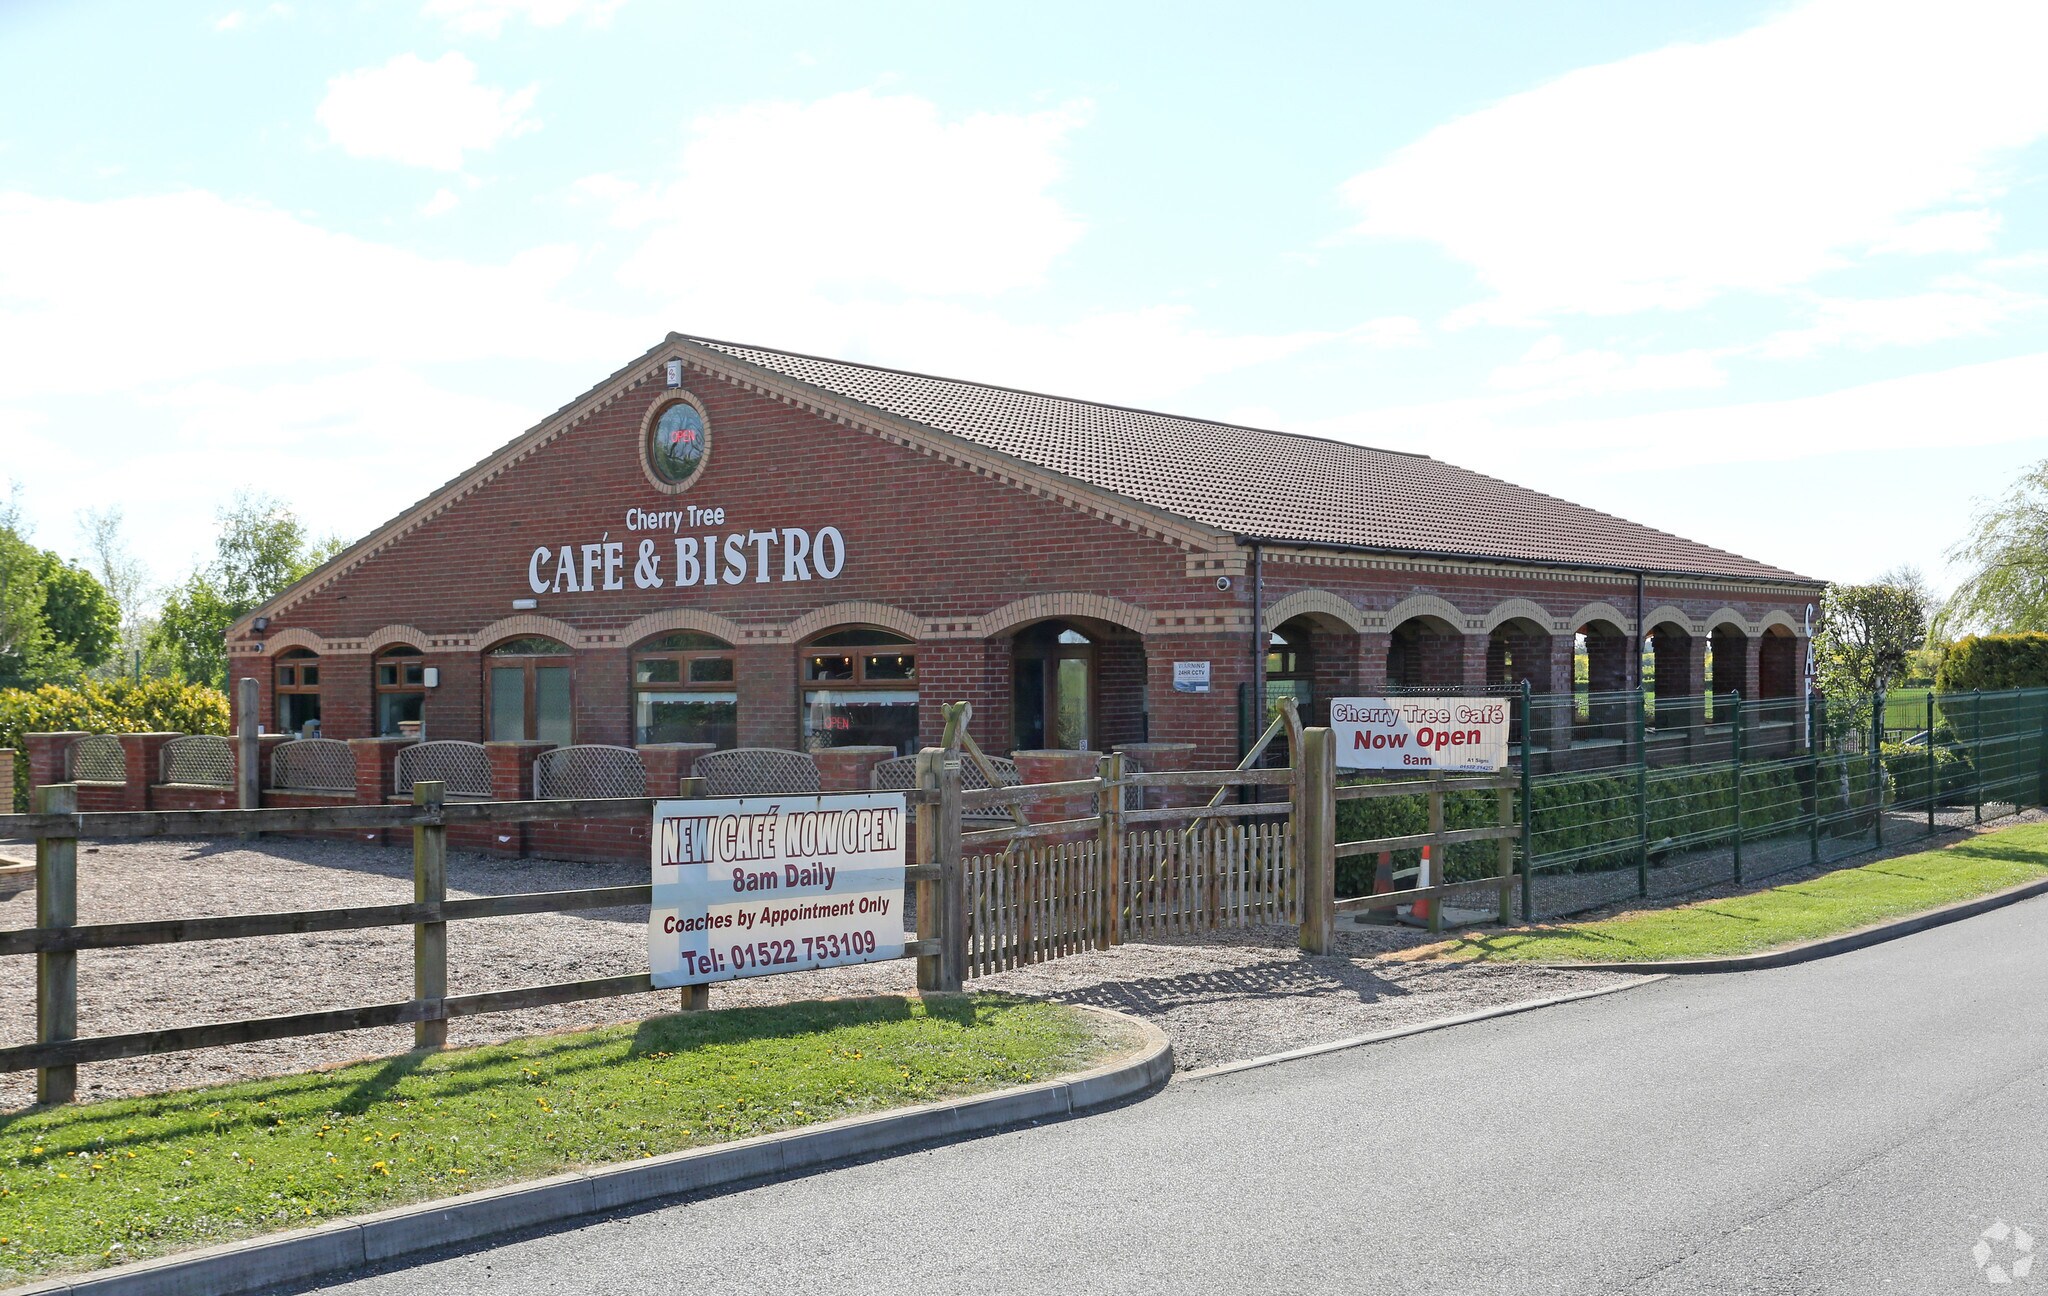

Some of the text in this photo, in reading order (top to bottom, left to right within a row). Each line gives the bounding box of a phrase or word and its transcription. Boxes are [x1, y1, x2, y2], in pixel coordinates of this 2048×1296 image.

[671, 429, 696, 442] OPEN
[625, 505, 726, 534] Cherry Tree
[528, 525, 846, 595] CAFÉ & BISTRO
[824, 716, 849, 730] OPEN
[1332, 703, 1504, 727] Cherry Tree Café
[1353, 727, 1482, 751] Now Open
[1402, 753, 1432, 766] 8am
[661, 804, 899, 867] NEW CAFÉ NOW OPEN
[732, 861, 836, 892] 8am Daily
[663, 896, 890, 934] Coaches by Appointment Only
[682, 930, 876, 976] Tel: 01522 753109
